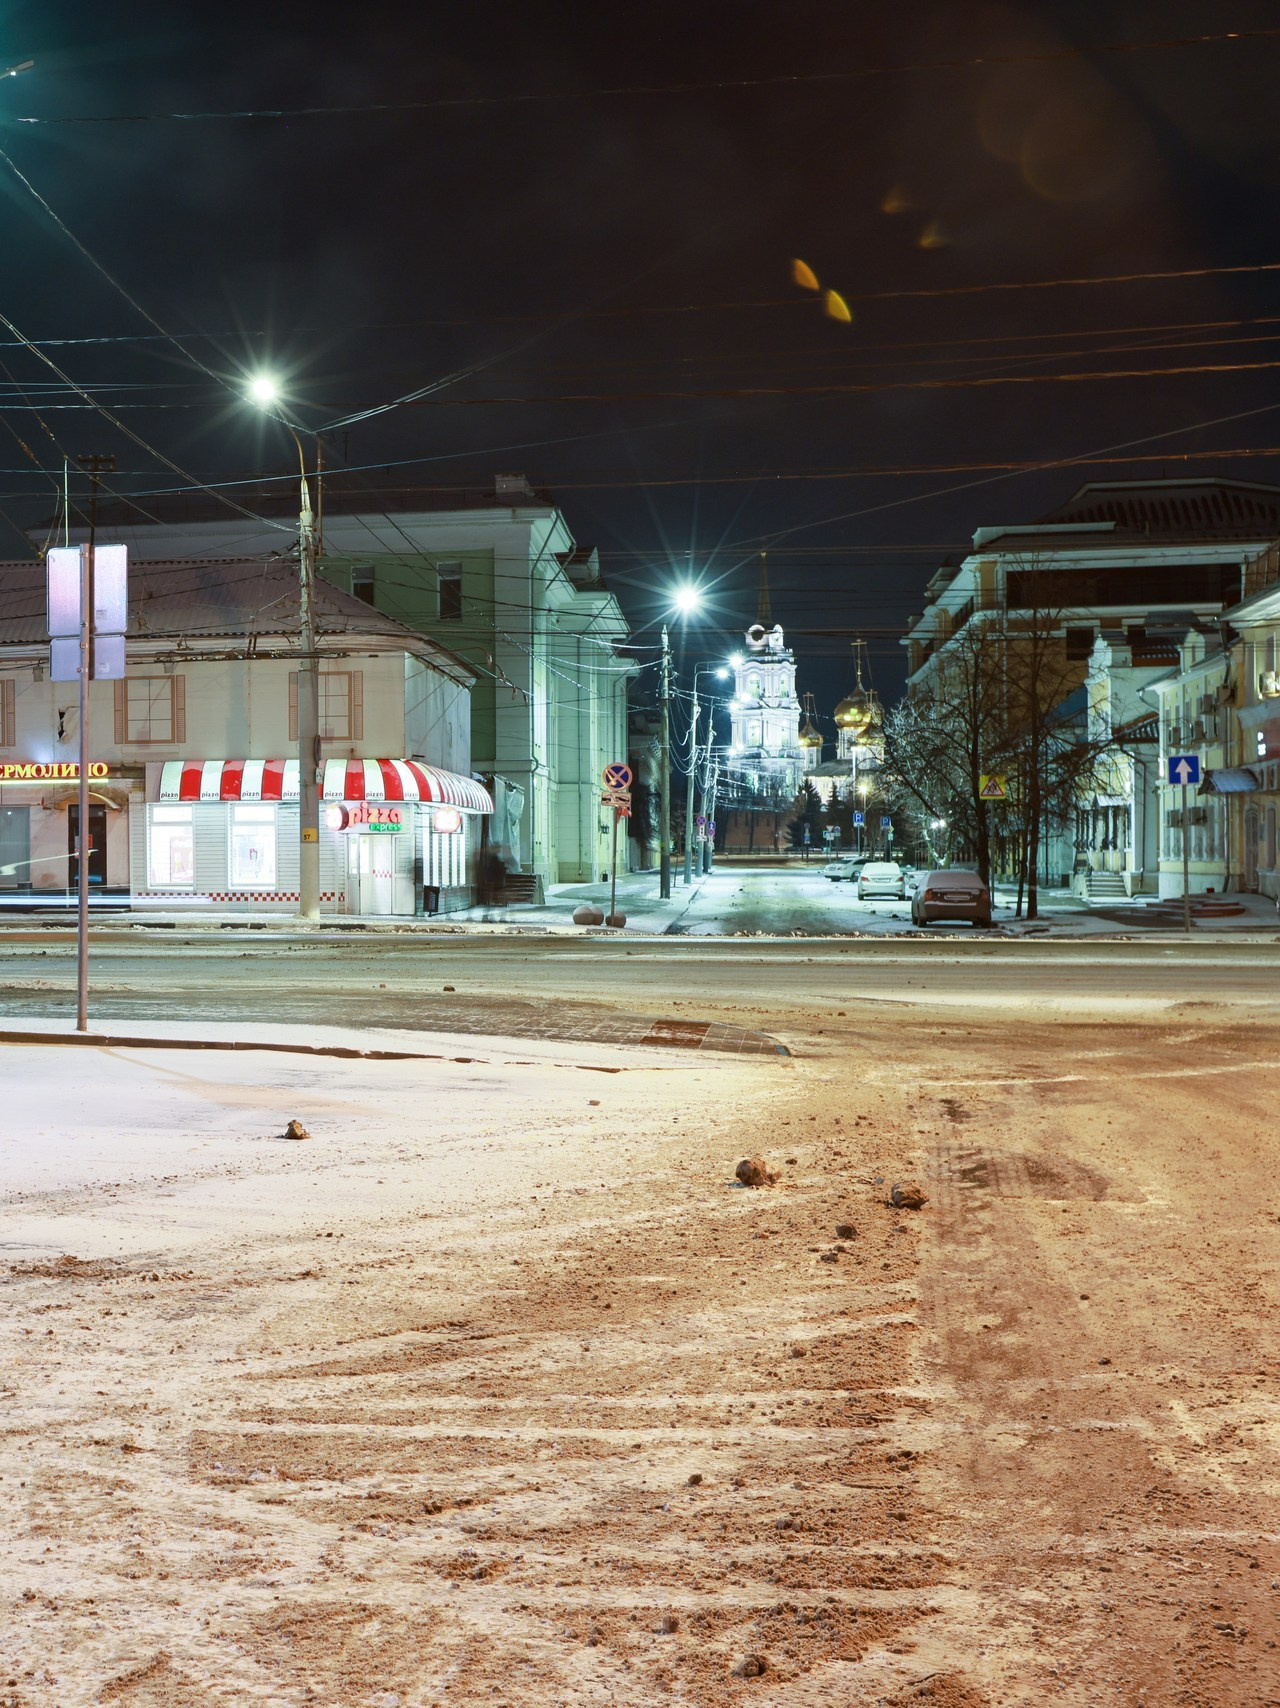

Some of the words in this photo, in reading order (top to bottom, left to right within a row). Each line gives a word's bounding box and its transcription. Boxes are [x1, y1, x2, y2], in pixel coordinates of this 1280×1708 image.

[160, 791, 179, 799] pizza
[241, 791, 260, 799] pizza
[324, 791, 343, 799] pizza
[365, 791, 384, 799] pizza
[348, 801, 403, 829] pizza
[369, 823, 403, 832] express
